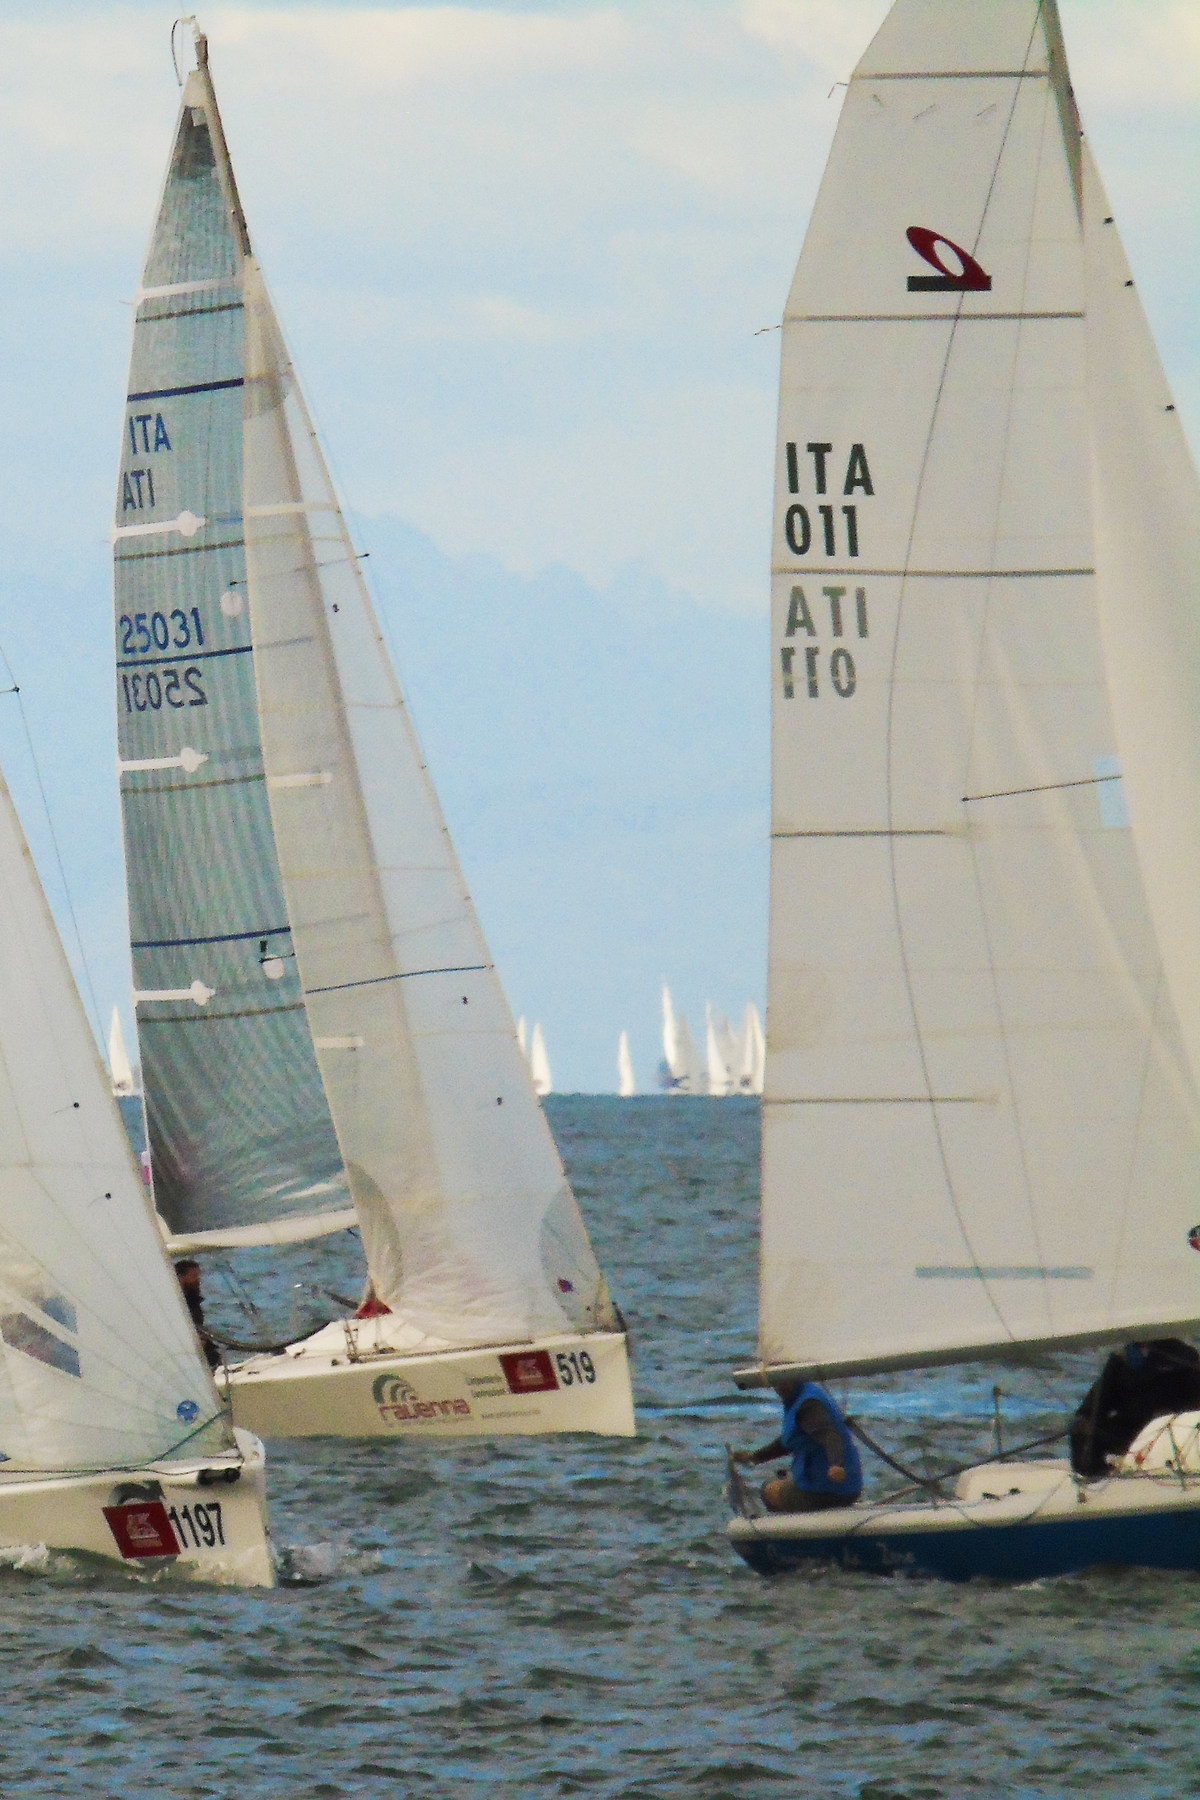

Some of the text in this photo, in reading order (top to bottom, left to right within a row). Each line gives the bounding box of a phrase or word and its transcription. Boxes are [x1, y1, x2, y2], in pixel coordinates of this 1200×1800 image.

[129, 412, 173, 455] ITA
[786, 441, 875, 496] ITA
[785, 503, 860, 557] 011
[119, 606, 205, 654] 25031
[555, 1350, 596, 1387] 519
[168, 1502, 227, 1549] 1197
